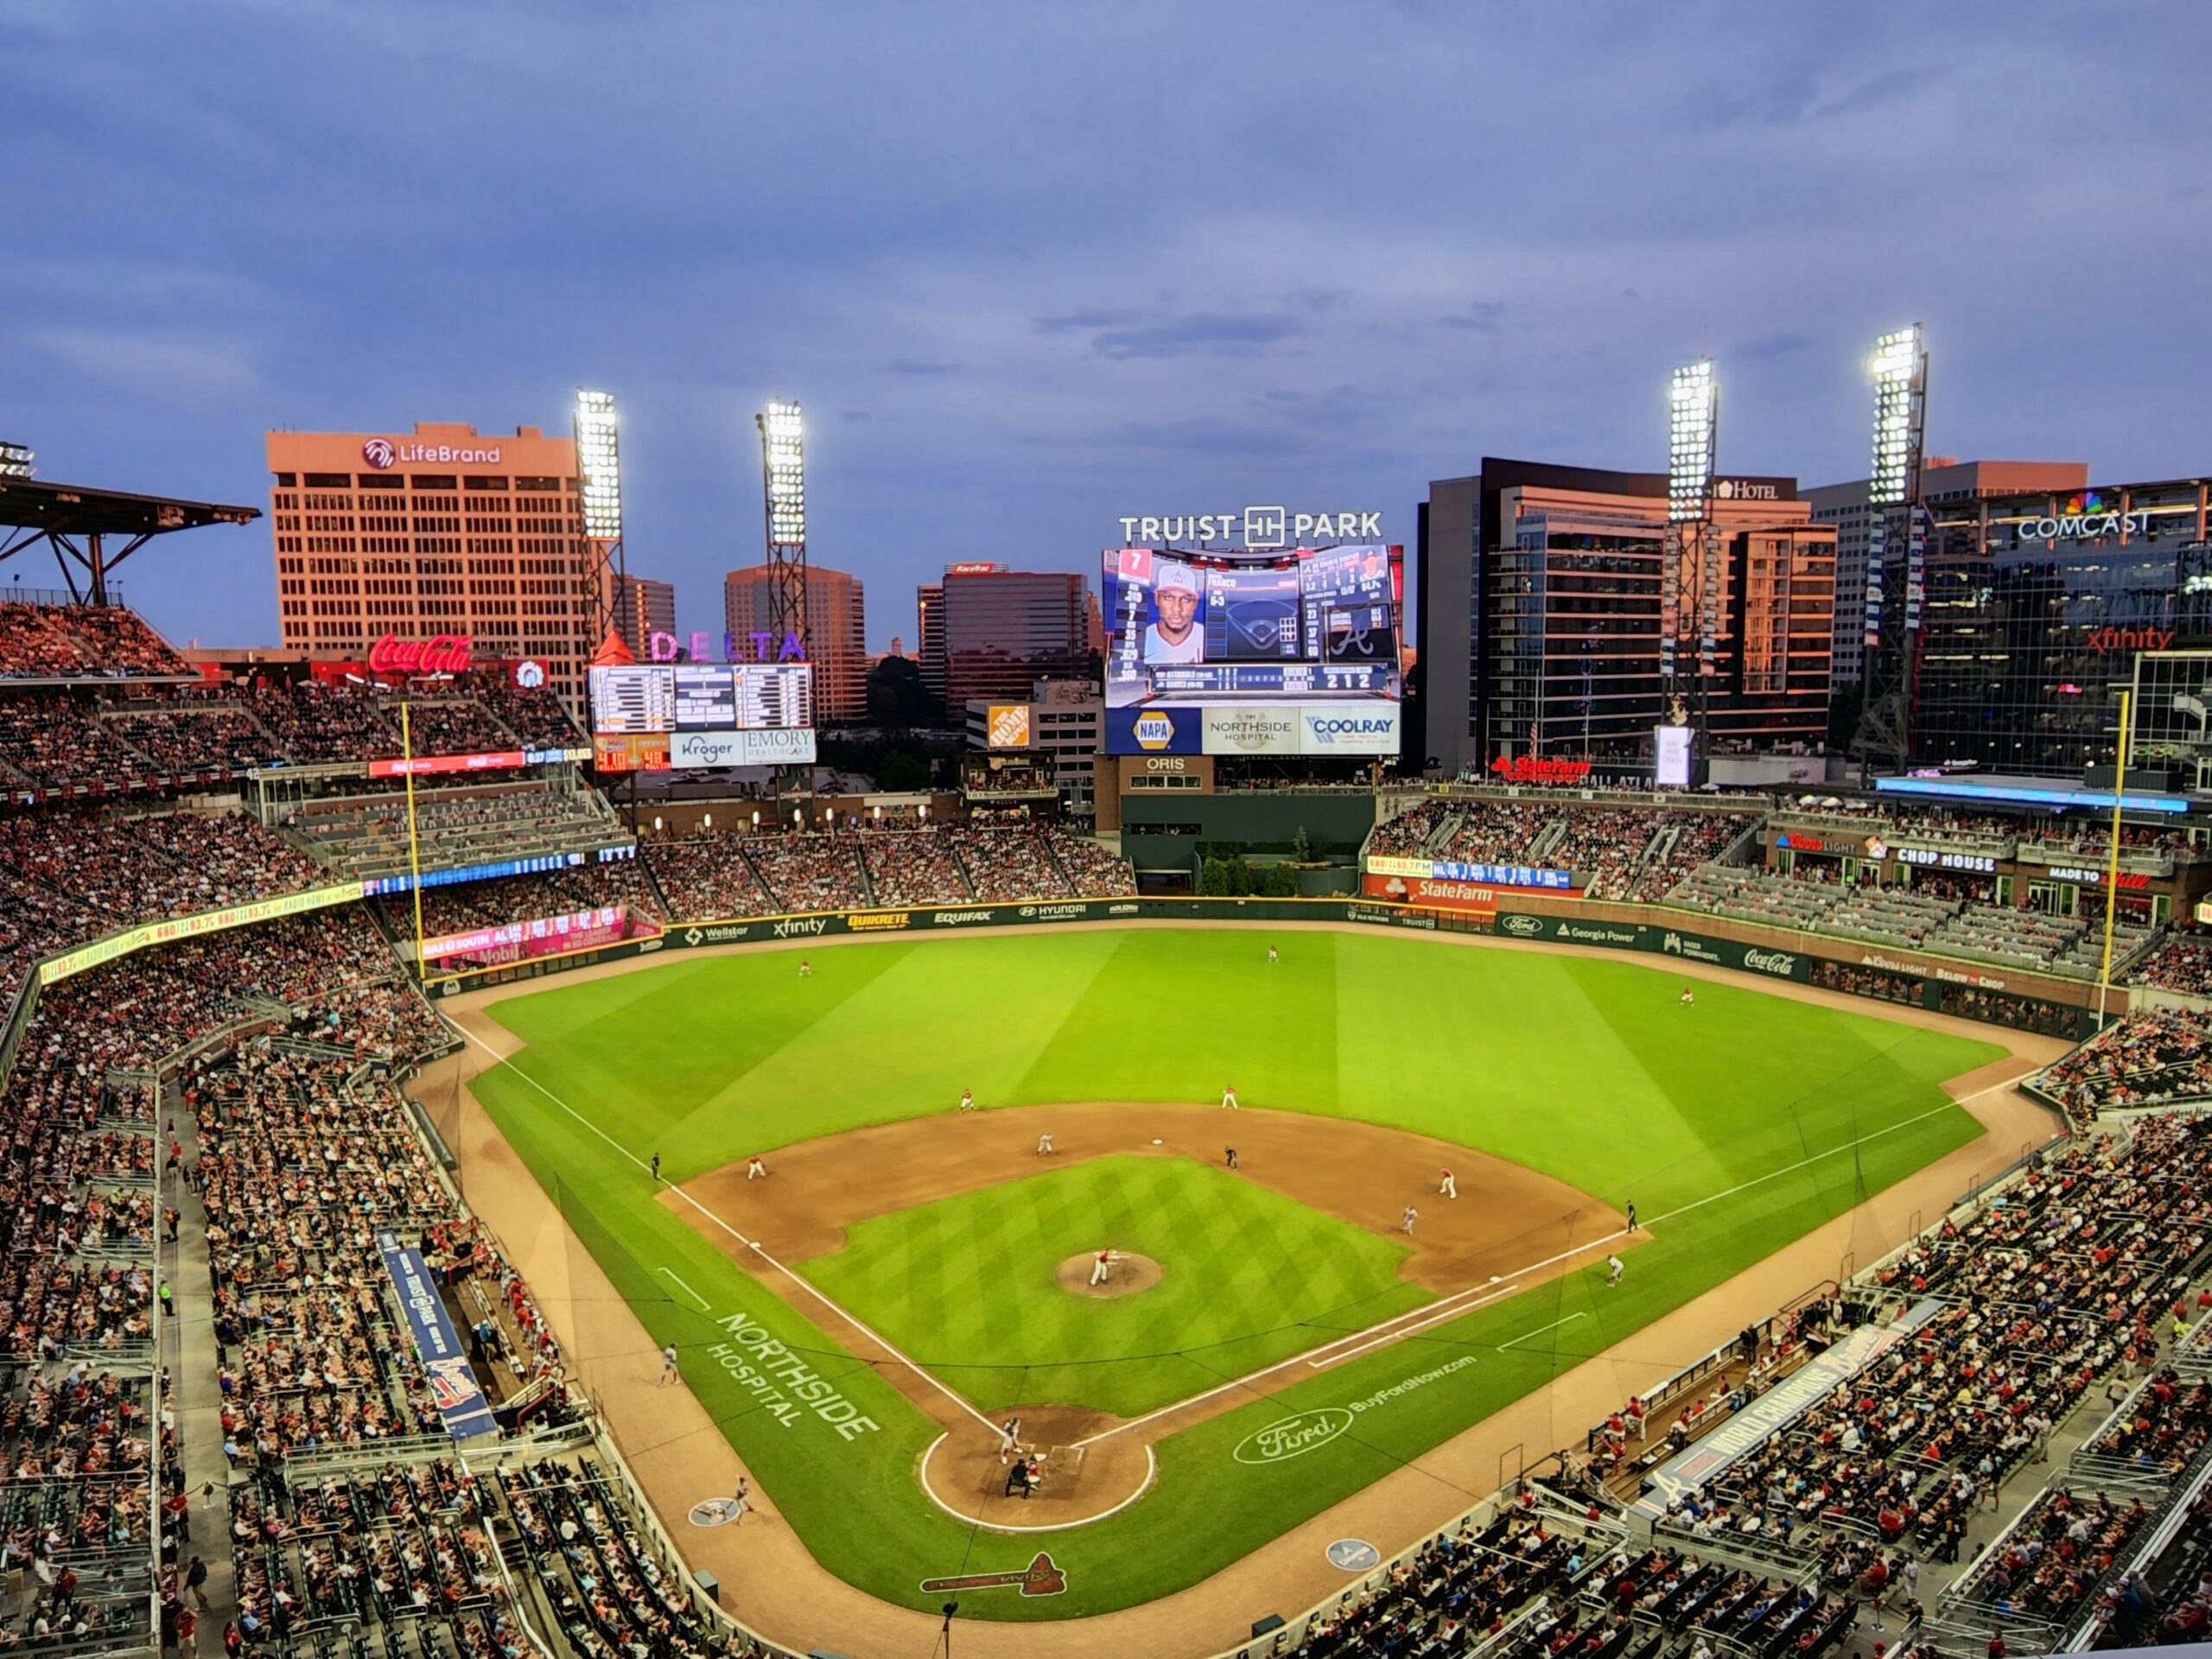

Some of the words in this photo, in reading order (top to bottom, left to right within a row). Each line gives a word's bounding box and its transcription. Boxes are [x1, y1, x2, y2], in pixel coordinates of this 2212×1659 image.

[400, 444, 500, 463] LifeBrand
[1733, 481, 1778, 499] HOTEL
[1119, 515, 1236, 543] TRUIST
[1294, 512, 1382, 538] PARK
[2018, 512, 2152, 539] COMCAST
[1130, 552, 1141, 570] 7
[1207, 577, 1236, 588] FRANCO
[651, 631, 806, 660] DELTA
[2086, 626, 2176, 655] xfinity
[1327, 675, 1338, 688] 2
[1344, 675, 1351, 688] 1
[1359, 674, 1370, 688] 2
[989, 705, 1028, 746] HOME
[1140, 722, 1167, 739] NAPA
[1211, 722, 1292, 732] NORTHSIDE
[1313, 719, 1394, 734] COOLRAY
[748, 731, 811, 747] EMORY
[683, 736, 733, 763] Kroger
[1147, 758, 1185, 770] ORIS
[246, 767, 259, 780] 42
[1789, 833, 1822, 851] Coors
[1823, 842, 1856, 854] LIGHT
[1897, 849, 1938, 865] CHOP
[1942, 853, 1995, 872] HOUSE
[1433, 865, 1446, 876] NL
[2050, 868, 2082, 880] MADE
[2083, 870, 2100, 882] TO
[283, 897, 304, 912] RADIO
[305, 892, 326, 906] HOME
[1039, 904, 1086, 916] HYUNDAI
[847, 913, 909, 927] QUIKRETE
[934, 911, 992, 925] EQUIFAX
[1402, 918, 1426, 928] TRUIST
[1509, 917, 1535, 931] Ford
[706, 927, 749, 938] Wellstar
[773, 918, 827, 938] xfinity
[1572, 927, 1605, 941] Georgia
[1607, 931, 1636, 943] Power
[456, 934, 489, 949] SOUTH
[494, 931, 508, 943] AL
[480, 944, 524, 963] Mobil
[1902, 963, 1928, 976] LIGHT
[1936, 968, 1969, 983] BELOW
[1978, 977, 2005, 990] CHOP
[707, 1344, 802, 1427] HOSPITAL
[715, 1313, 881, 1441] NORTHSIDE
[1348, 1354, 1477, 1413] BuyFordNow.com
[1706, 1416, 1770, 1455] WORLD
[1752, 1368, 1838, 1422] CHAMPIONS
[1256, 1416, 1337, 1458] Ford
